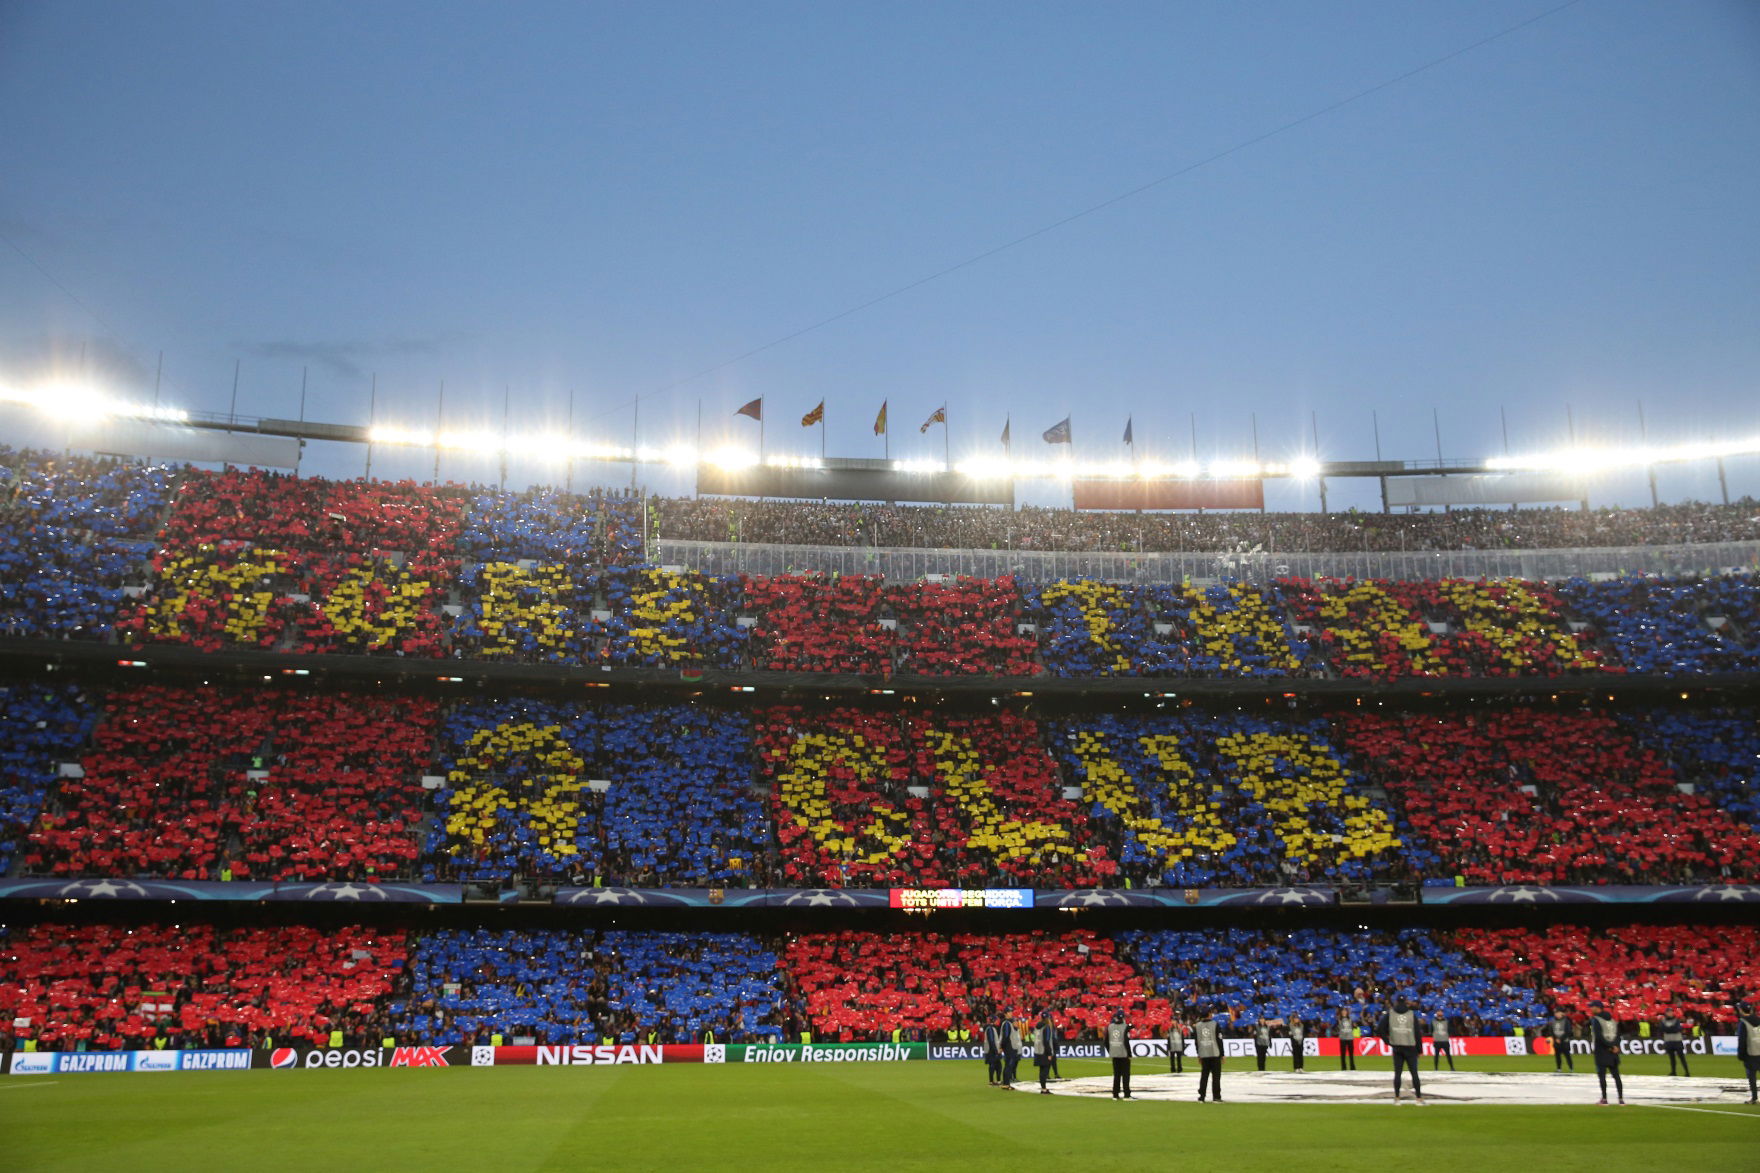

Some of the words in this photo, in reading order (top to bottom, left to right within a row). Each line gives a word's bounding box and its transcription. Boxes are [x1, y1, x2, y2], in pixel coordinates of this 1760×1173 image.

[776, 727, 1402, 868] CLUB
[900, 898, 928, 907] TOTS
[536, 1044, 664, 1065] NISSAN
[932, 1045, 968, 1058] UEFA
[1055, 1045, 1102, 1057] EAGUE
[1569, 1036, 1707, 1055] mtercrd
[59, 1054, 128, 1072] GAZPROM
[182, 1052, 248, 1069] GAZPROM
[305, 1047, 384, 1068] pepsi
[389, 1046, 454, 1067] MAX
